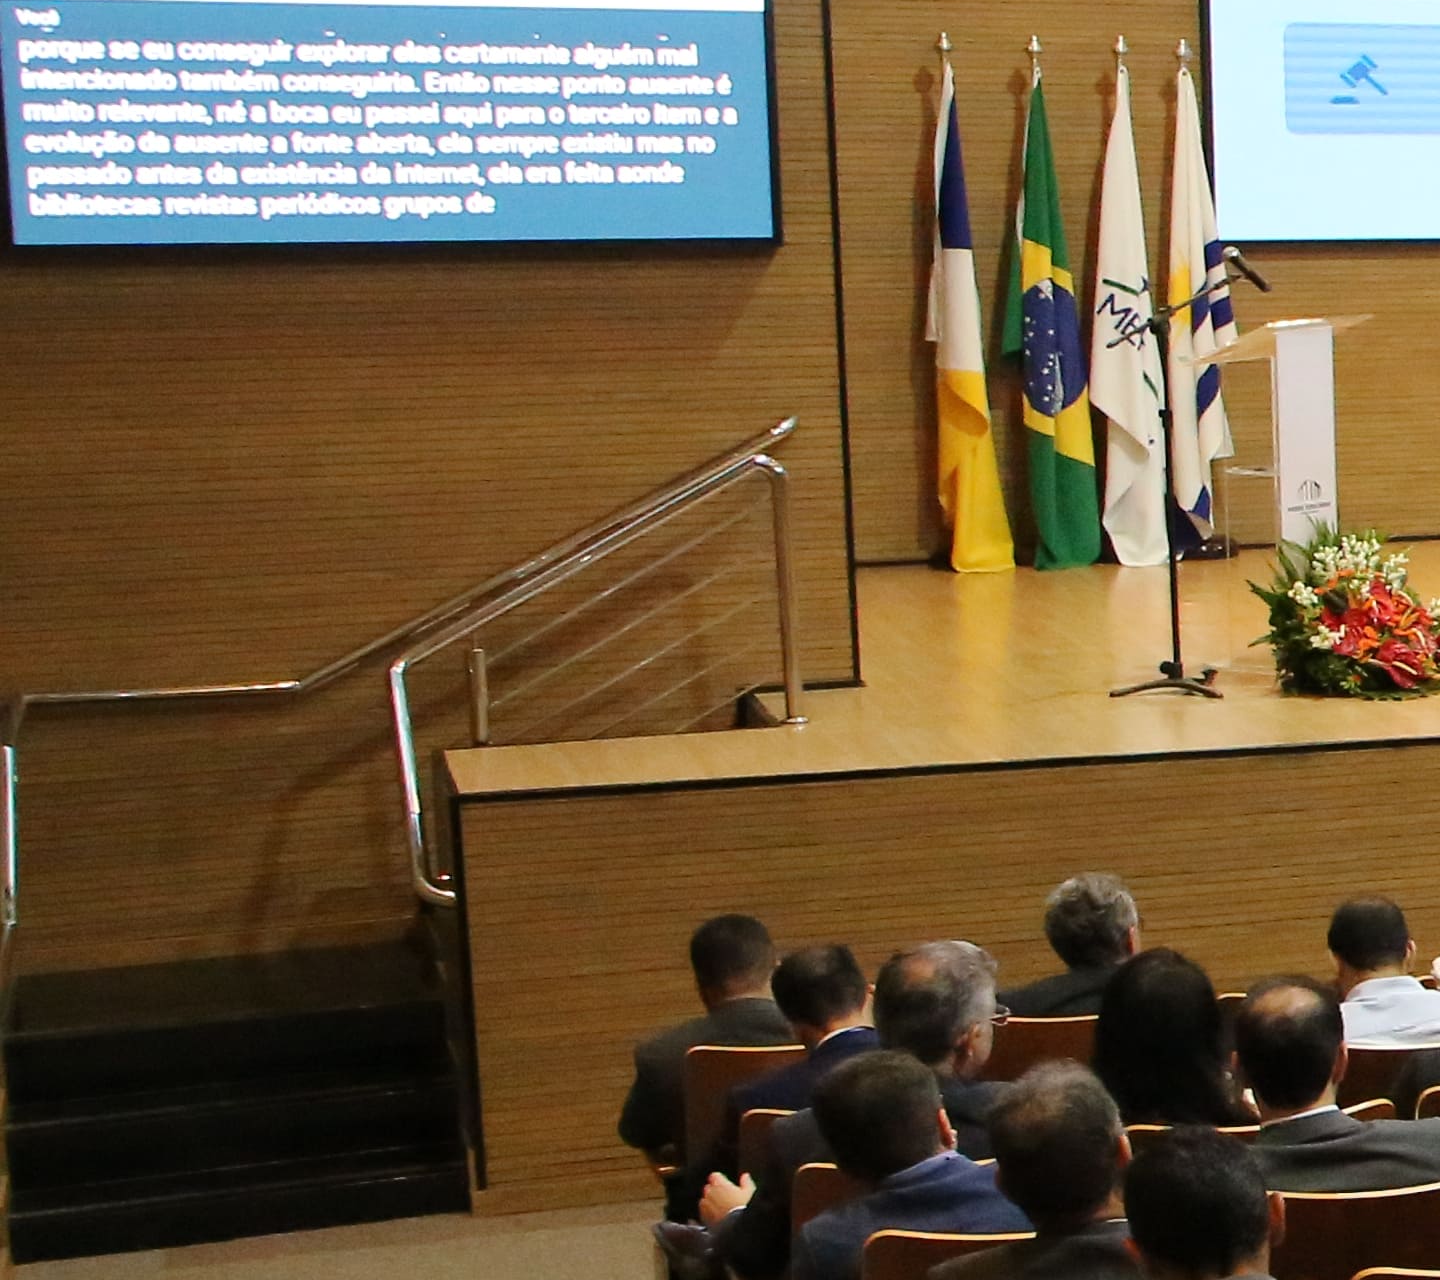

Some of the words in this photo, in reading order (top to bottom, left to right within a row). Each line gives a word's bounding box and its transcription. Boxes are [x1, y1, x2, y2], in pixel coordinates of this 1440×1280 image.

[18, 40, 104, 63] porque
[108, 41, 140, 59] se
[142, 41, 174, 60] eu
[177, 40, 293, 66] conseguir
[296, 39, 390, 66] explorar
[443, 43, 570, 64] certamente
[573, 43, 654, 69] alguém
[656, 44, 697, 65] mal
[20, 68, 177, 90] intencionado
[178, 70, 279, 91] também
[424, 71, 490, 92] Então
[492, 76, 560, 93] nesse
[561, 74, 626, 99] ponto
[628, 75, 714, 94] ausente
[715, 74, 731, 94] é
[22, 100, 94, 122] muito
[97, 99, 212, 124] relevante,
[215, 100, 247, 122] né
[331, 106, 362, 123] eu
[365, 102, 439, 127] passei
[443, 102, 492, 128] aqui
[495, 106, 545, 128] para
[548, 107, 565, 124] o
[567, 103, 651, 124] terceiro
[704, 107, 719, 124] e
[24, 130, 135, 158] evolução
[137, 131, 170, 152] da
[174, 133, 268, 153] ausente
[290, 131, 353, 153] fonte
[355, 132, 435, 155] aberta,
[437, 132, 473, 153] ela
[475, 135, 559, 158] sempre
[686, 136, 715, 153] no
[27, 161, 132, 189] passado
[135, 164, 202, 184] antes
[206, 162, 237, 184] da
[360, 162, 391, 184] da
[487, 161, 523, 183] ela
[525, 166, 561, 183] era
[564, 161, 614, 183] feita
[29, 193, 161, 215] bibliotecas
[164, 193, 257, 214] revistas
[383, 196, 462, 219] grupos
[465, 191, 495, 213] de
